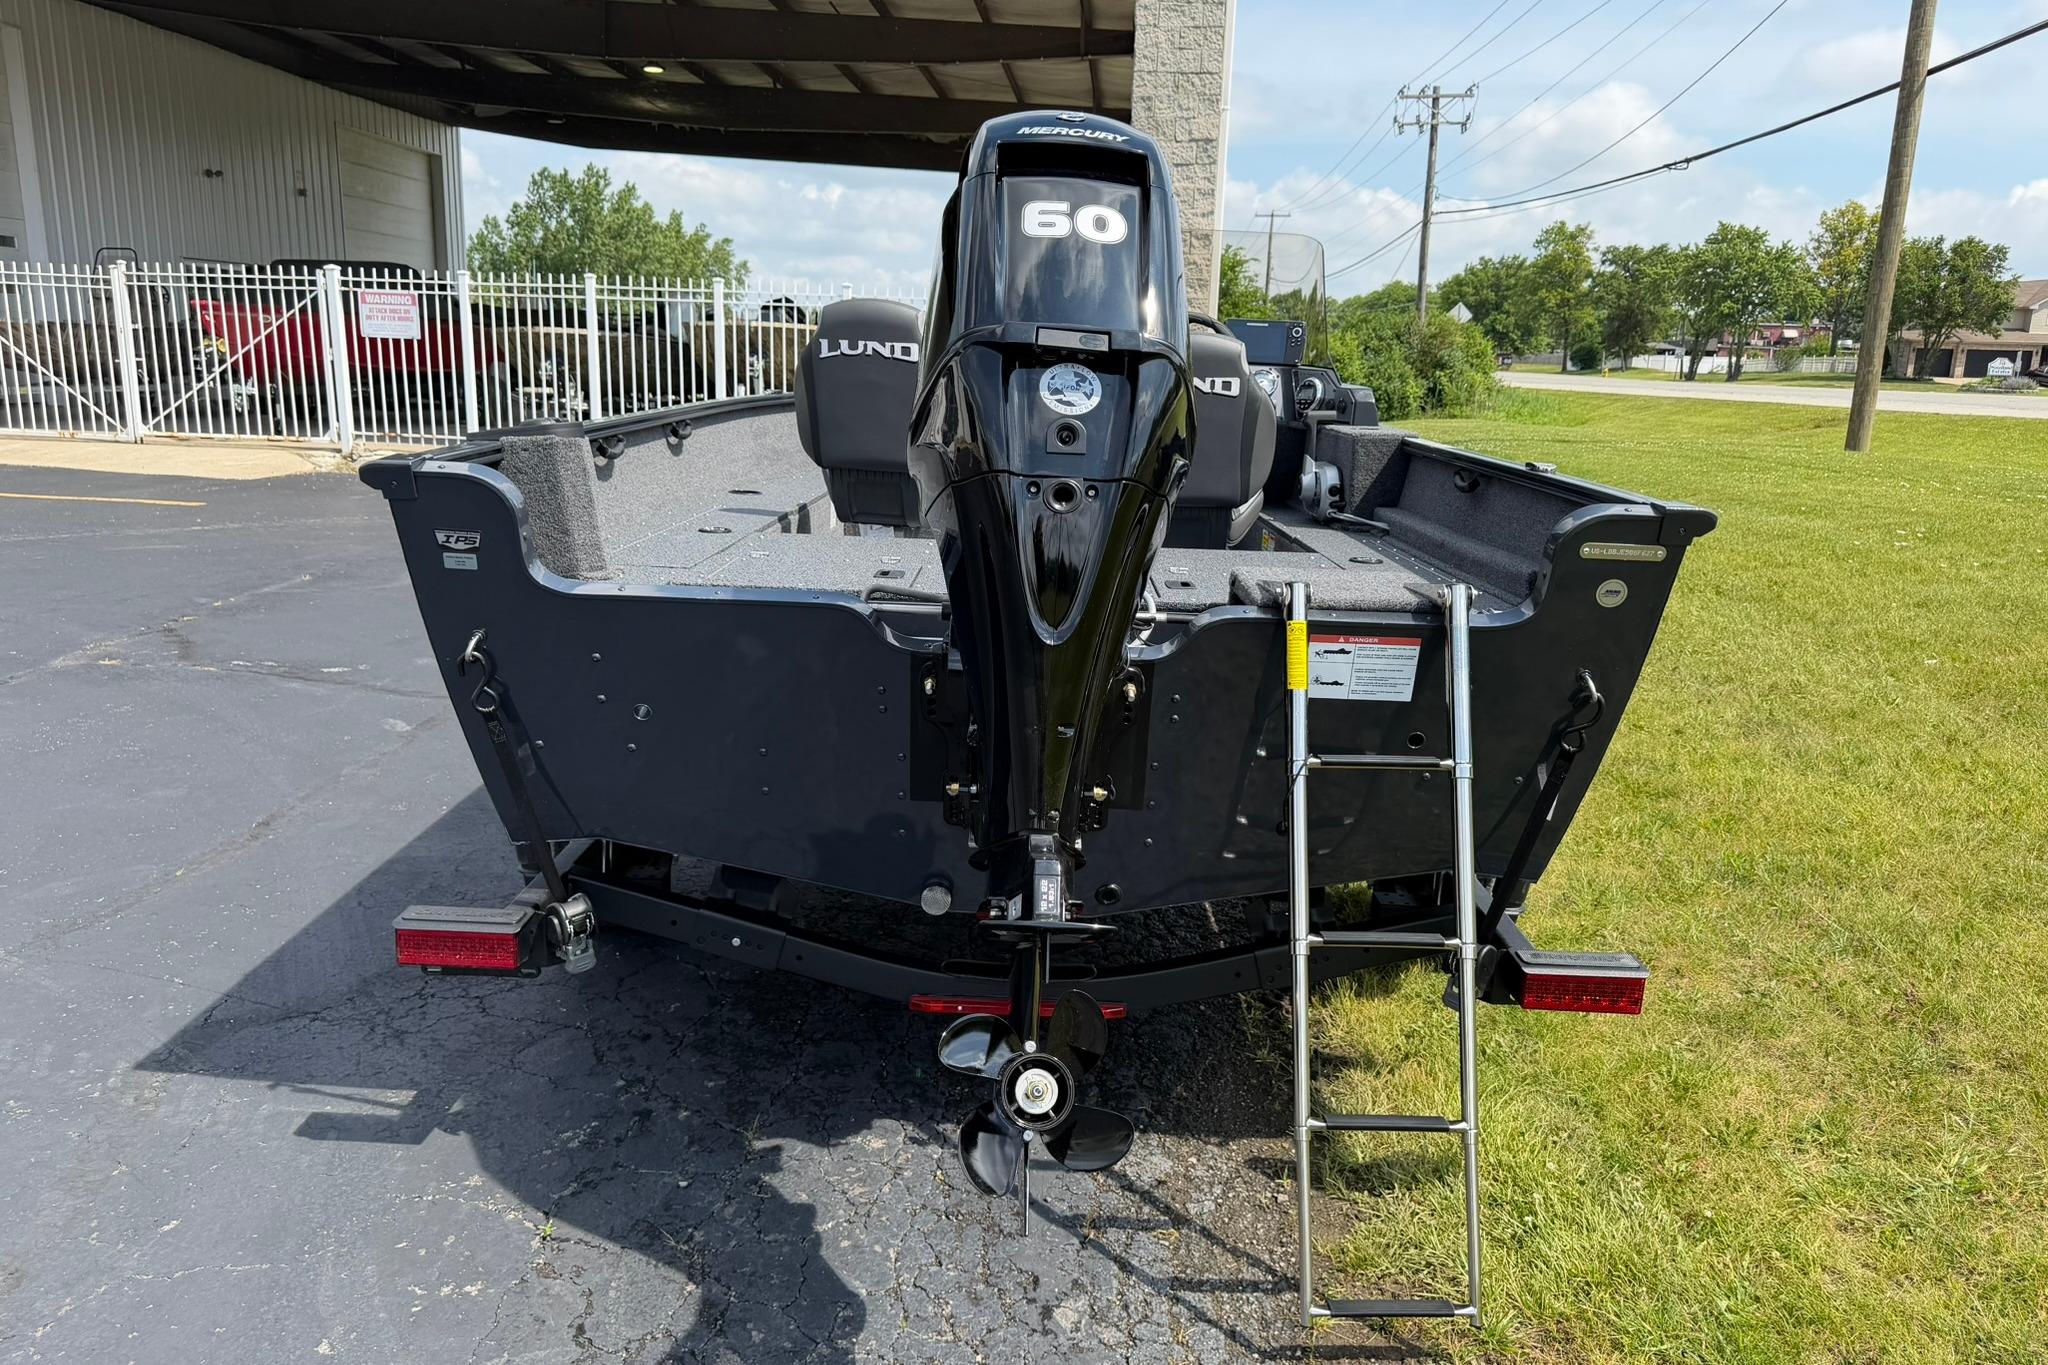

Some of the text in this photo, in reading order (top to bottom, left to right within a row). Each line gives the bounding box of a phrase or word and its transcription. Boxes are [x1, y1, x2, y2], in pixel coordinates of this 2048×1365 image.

[1017, 126, 1130, 142] MERCURY
[1021, 200, 1128, 244] 60
[364, 293, 412, 305] WARNING
[818, 338, 919, 363] LUND
[1192, 377, 1241, 397] ND
[441, 534, 479, 546] IPS
[1041, 879, 1048, 892] 22
